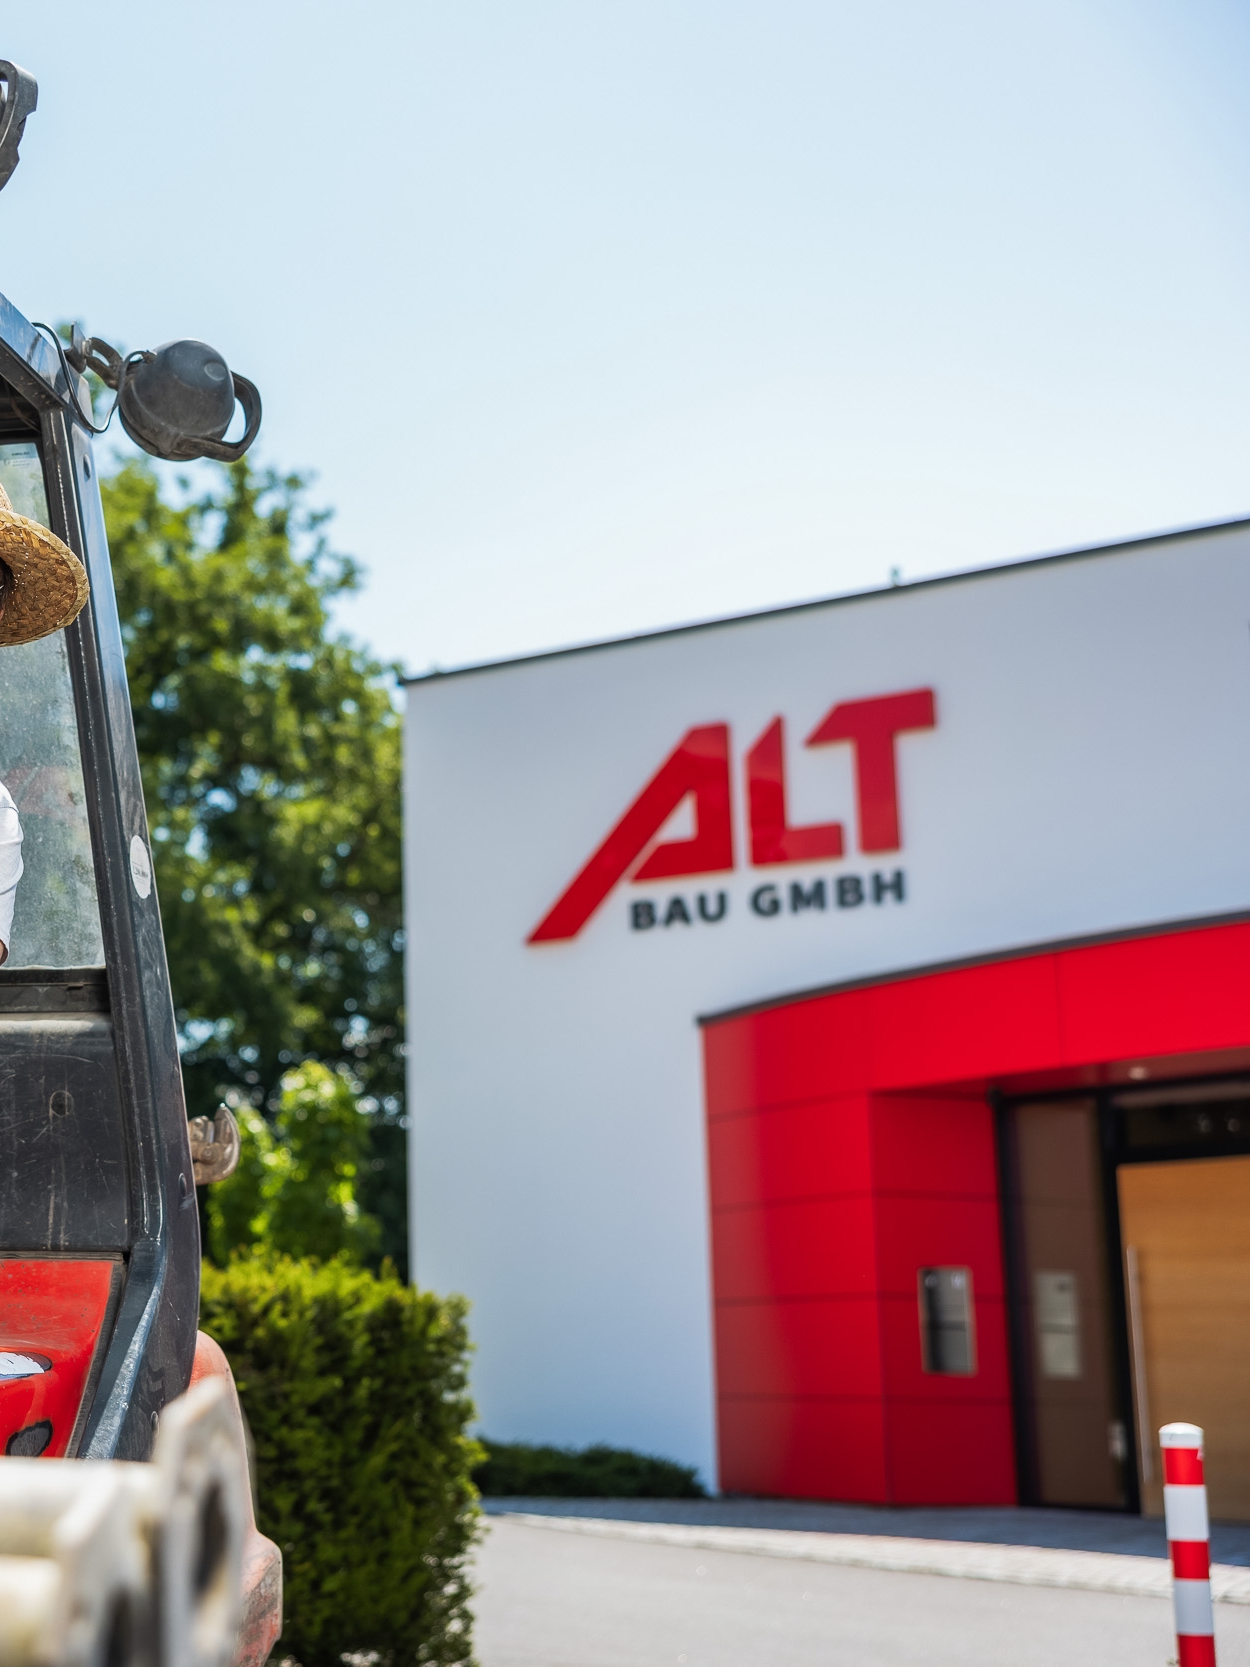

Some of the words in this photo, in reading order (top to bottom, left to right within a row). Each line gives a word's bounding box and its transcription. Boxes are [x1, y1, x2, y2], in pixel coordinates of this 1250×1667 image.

[525, 685, 937, 946] ALT
[630, 891, 729, 930] BAU
[751, 867, 907, 917] GMBH
